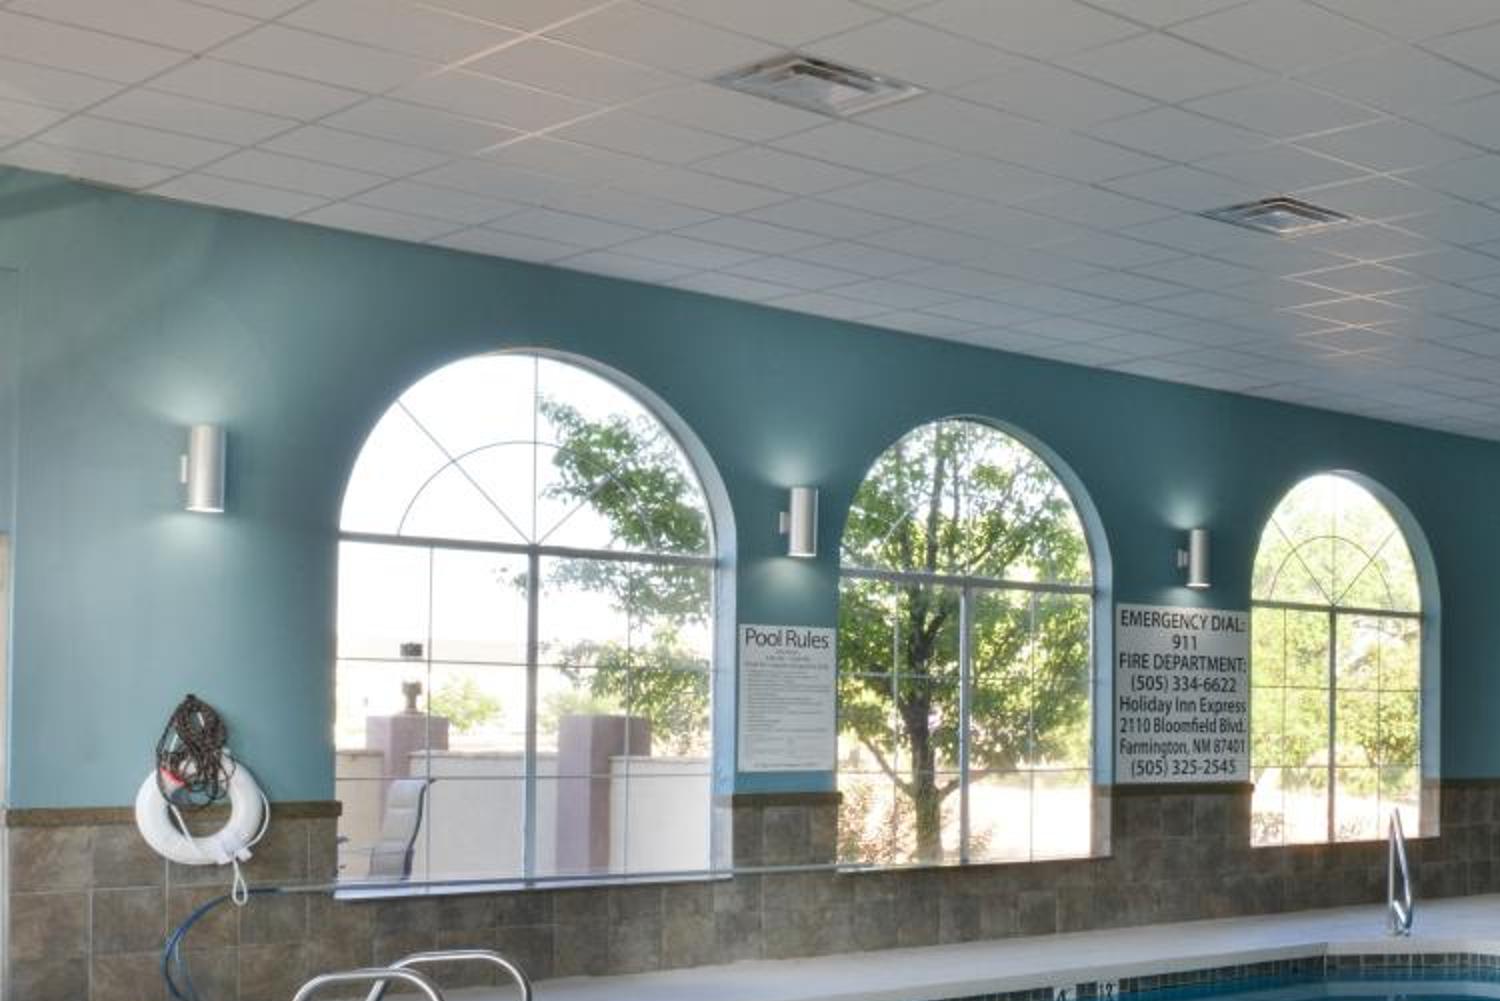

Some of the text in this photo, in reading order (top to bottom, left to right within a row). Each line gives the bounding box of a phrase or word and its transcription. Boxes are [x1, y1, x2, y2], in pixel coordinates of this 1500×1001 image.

[1121, 609, 1246, 632] EMERGENCY DIAL:
[745, 627, 829, 649] Pool Rules
[1172, 634, 1197, 650] 911
[1119, 652, 1247, 673] FIRE DEPARTMENT:
[1131, 675, 1236, 693] (505) 334-6622
[1120, 696, 1247, 716] Holiday Inn Express
[1120, 717, 1246, 733] 2110 Bloomfield Blvd.
[1120, 738, 1246, 758] Farmington, NM 87401
[1131, 759, 1236, 778] (505) 325-2545
